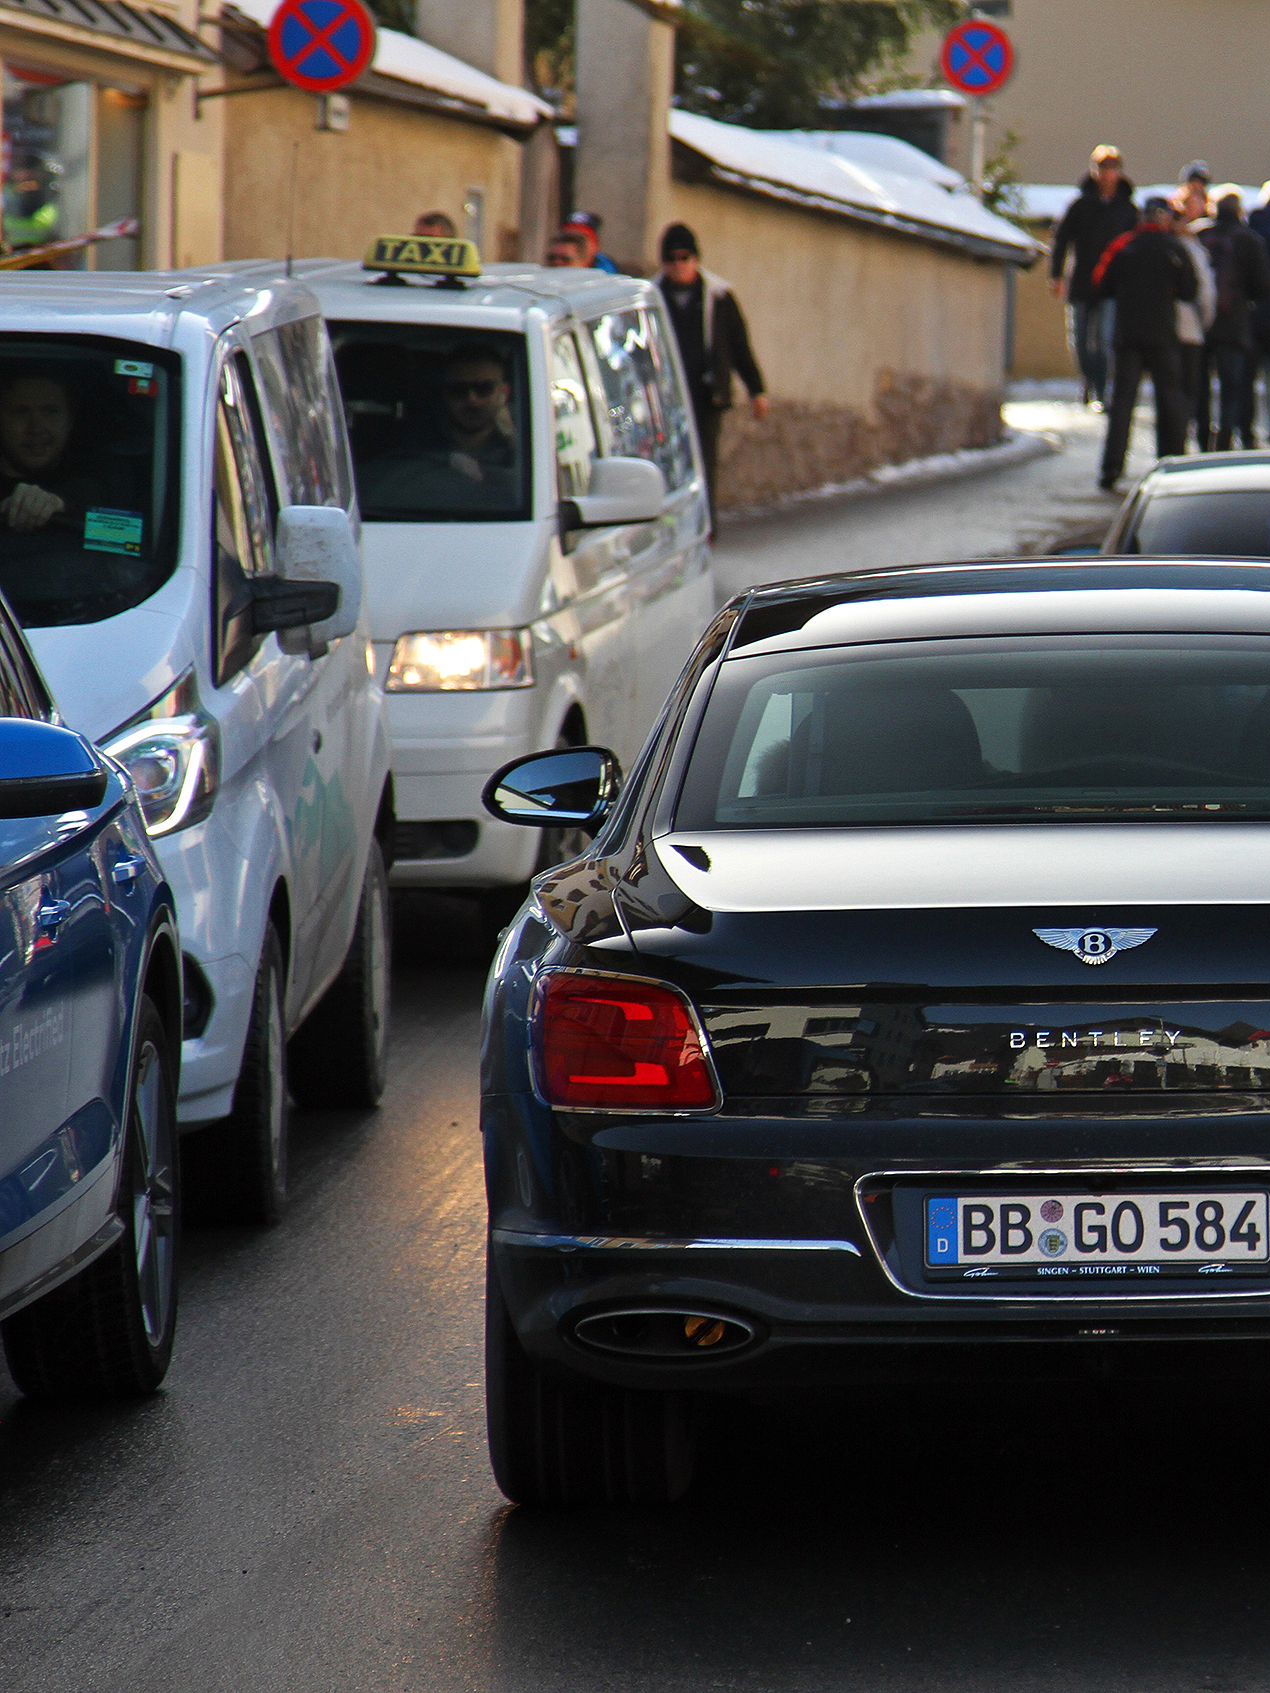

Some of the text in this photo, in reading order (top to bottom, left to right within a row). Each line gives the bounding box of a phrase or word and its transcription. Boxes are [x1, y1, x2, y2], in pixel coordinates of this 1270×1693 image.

[382, 240, 462, 266] TAXI
[1009, 1030, 1182, 1049] BENTLEY
[962, 1200, 1261, 1256] BB GO 584
[937, 1238, 949, 1253] D
[1037, 1267, 1069, 1276] SINGEN
[1079, 1266, 1127, 1275] STUTTGART
[1137, 1265, 1160, 1274] WIEN
